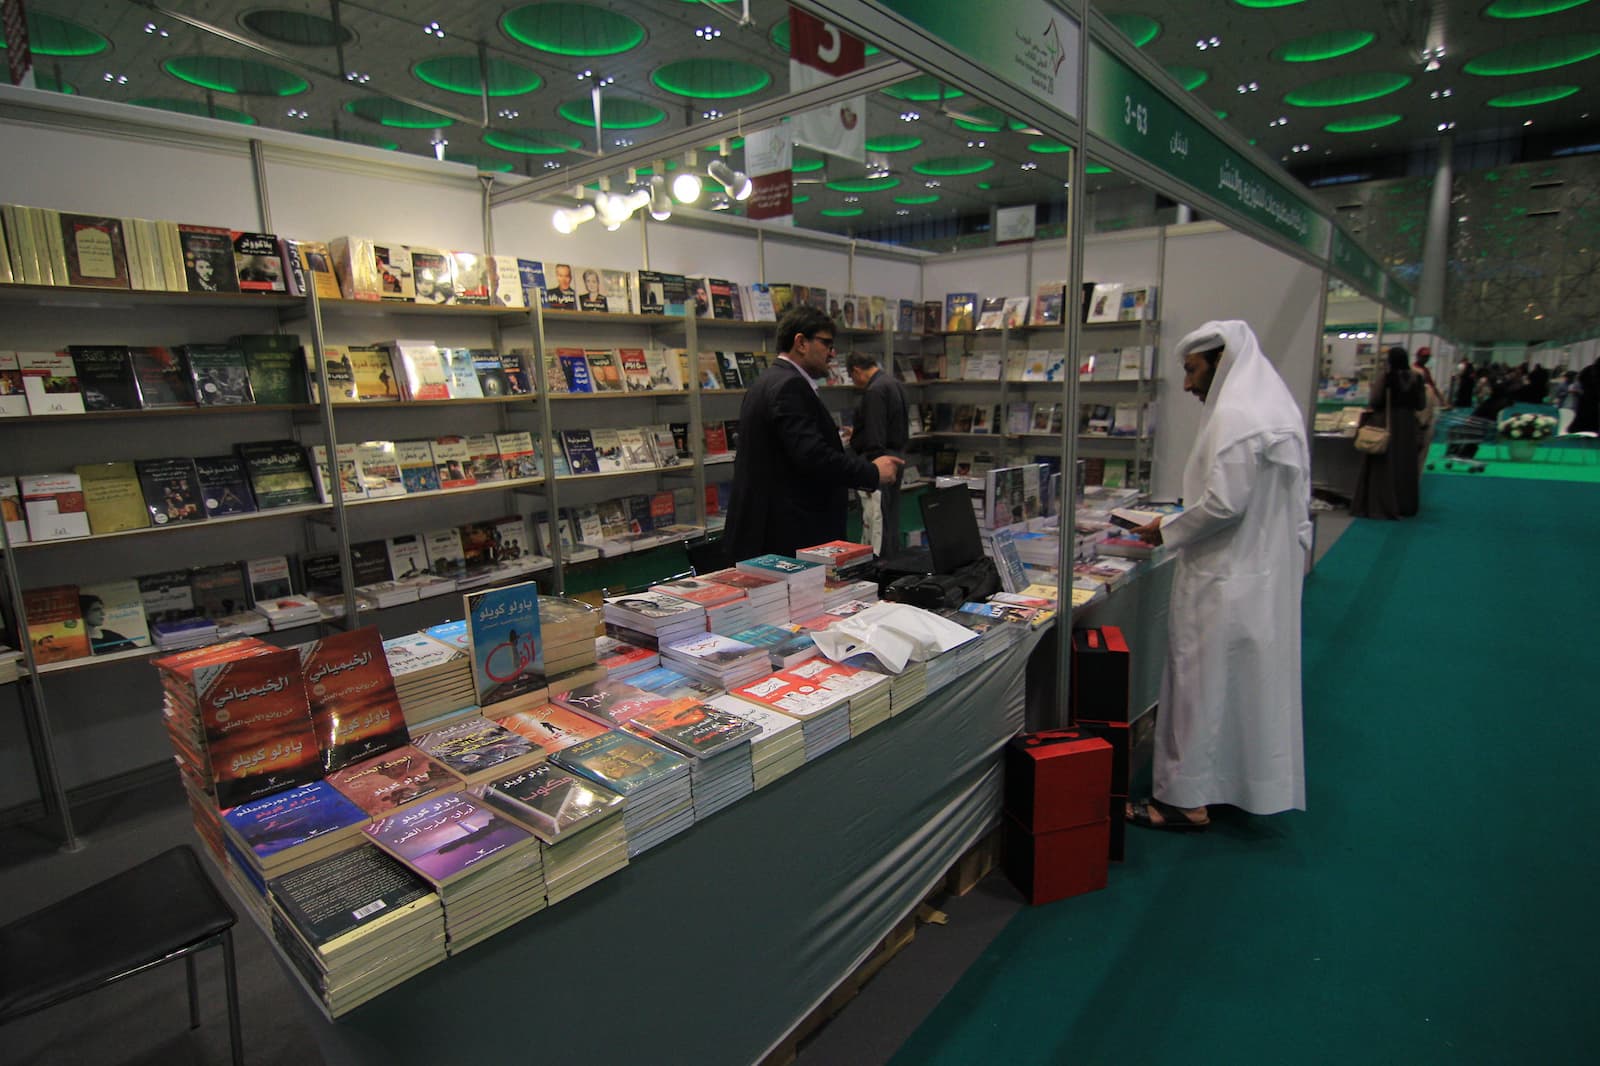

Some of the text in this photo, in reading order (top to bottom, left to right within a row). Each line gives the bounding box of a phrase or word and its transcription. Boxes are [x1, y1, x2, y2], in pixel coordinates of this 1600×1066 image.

[1124, 95, 1148, 135] 3-63
[1169, 130, 1189, 160] لبنان
[479, 603, 506, 622] كويلو
[308, 651, 373, 683] الخيميائي
[212, 676, 289, 708] الخيميائي
[231, 747, 266, 772] كويلو
